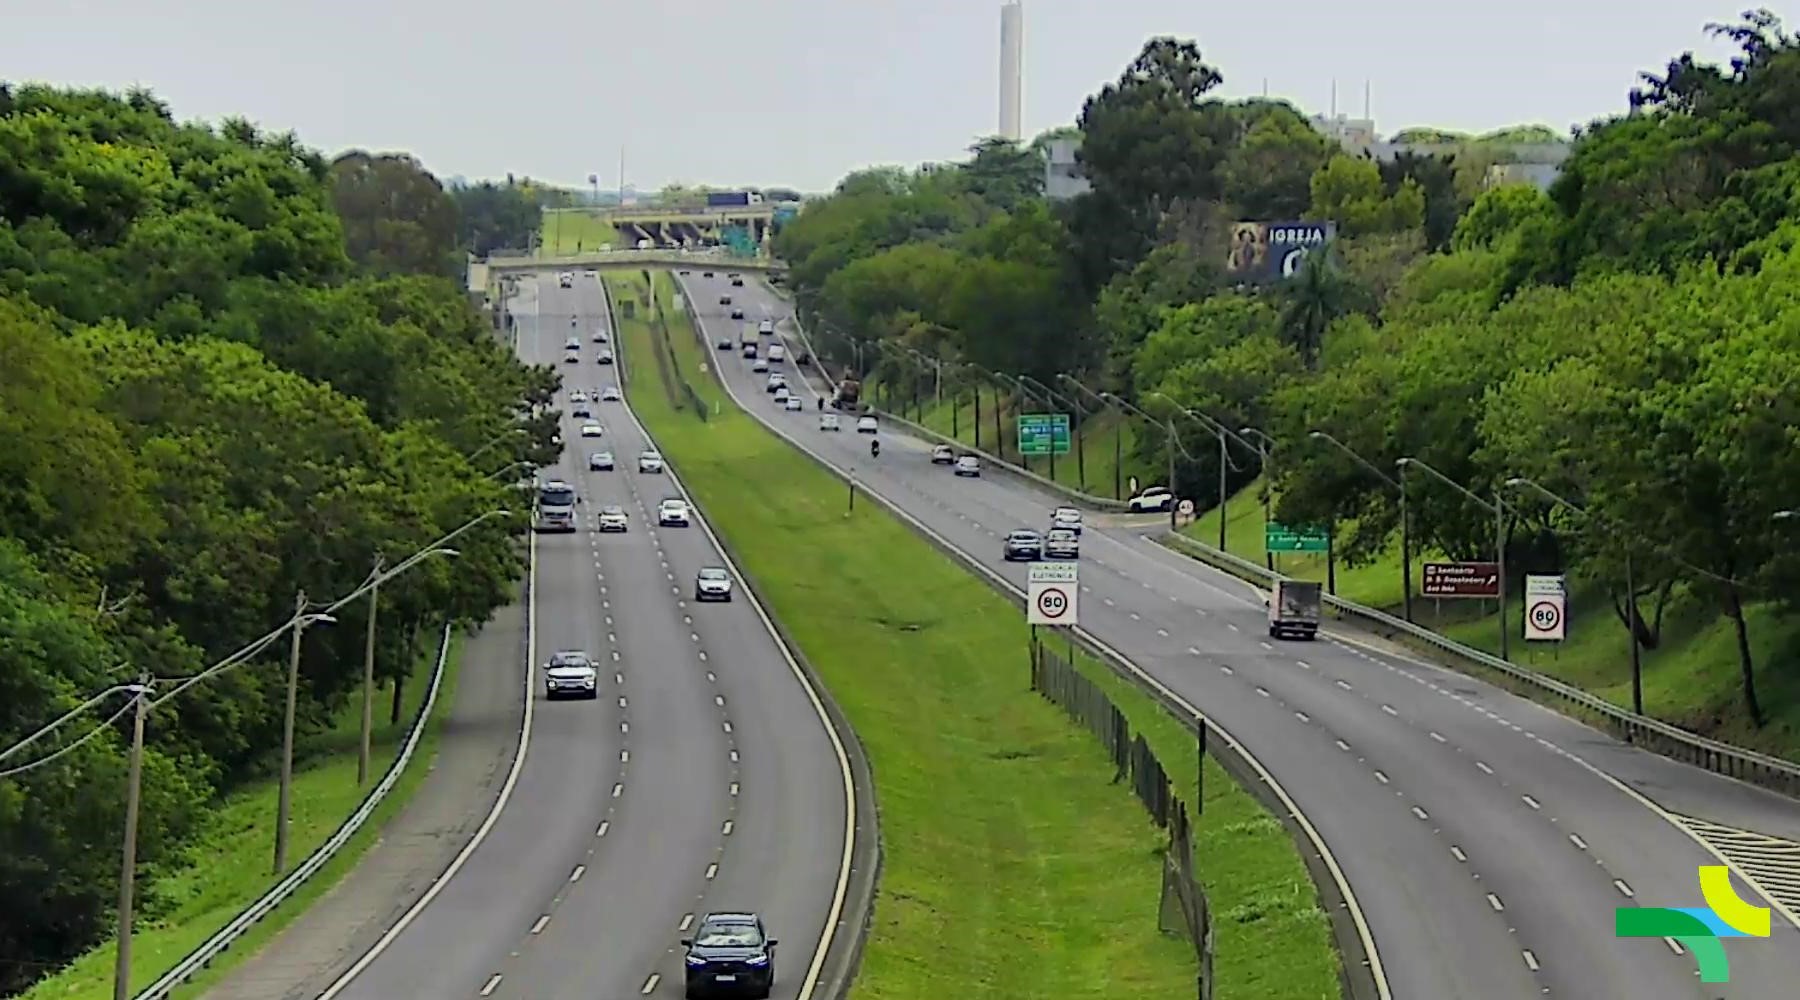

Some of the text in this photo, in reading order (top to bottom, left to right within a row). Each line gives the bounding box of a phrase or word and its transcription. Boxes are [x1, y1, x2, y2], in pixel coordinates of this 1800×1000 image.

[1269, 228, 1323, 243] IGREJA
[1044, 597, 1062, 608] 80
[1536, 611, 1554, 622] 80
